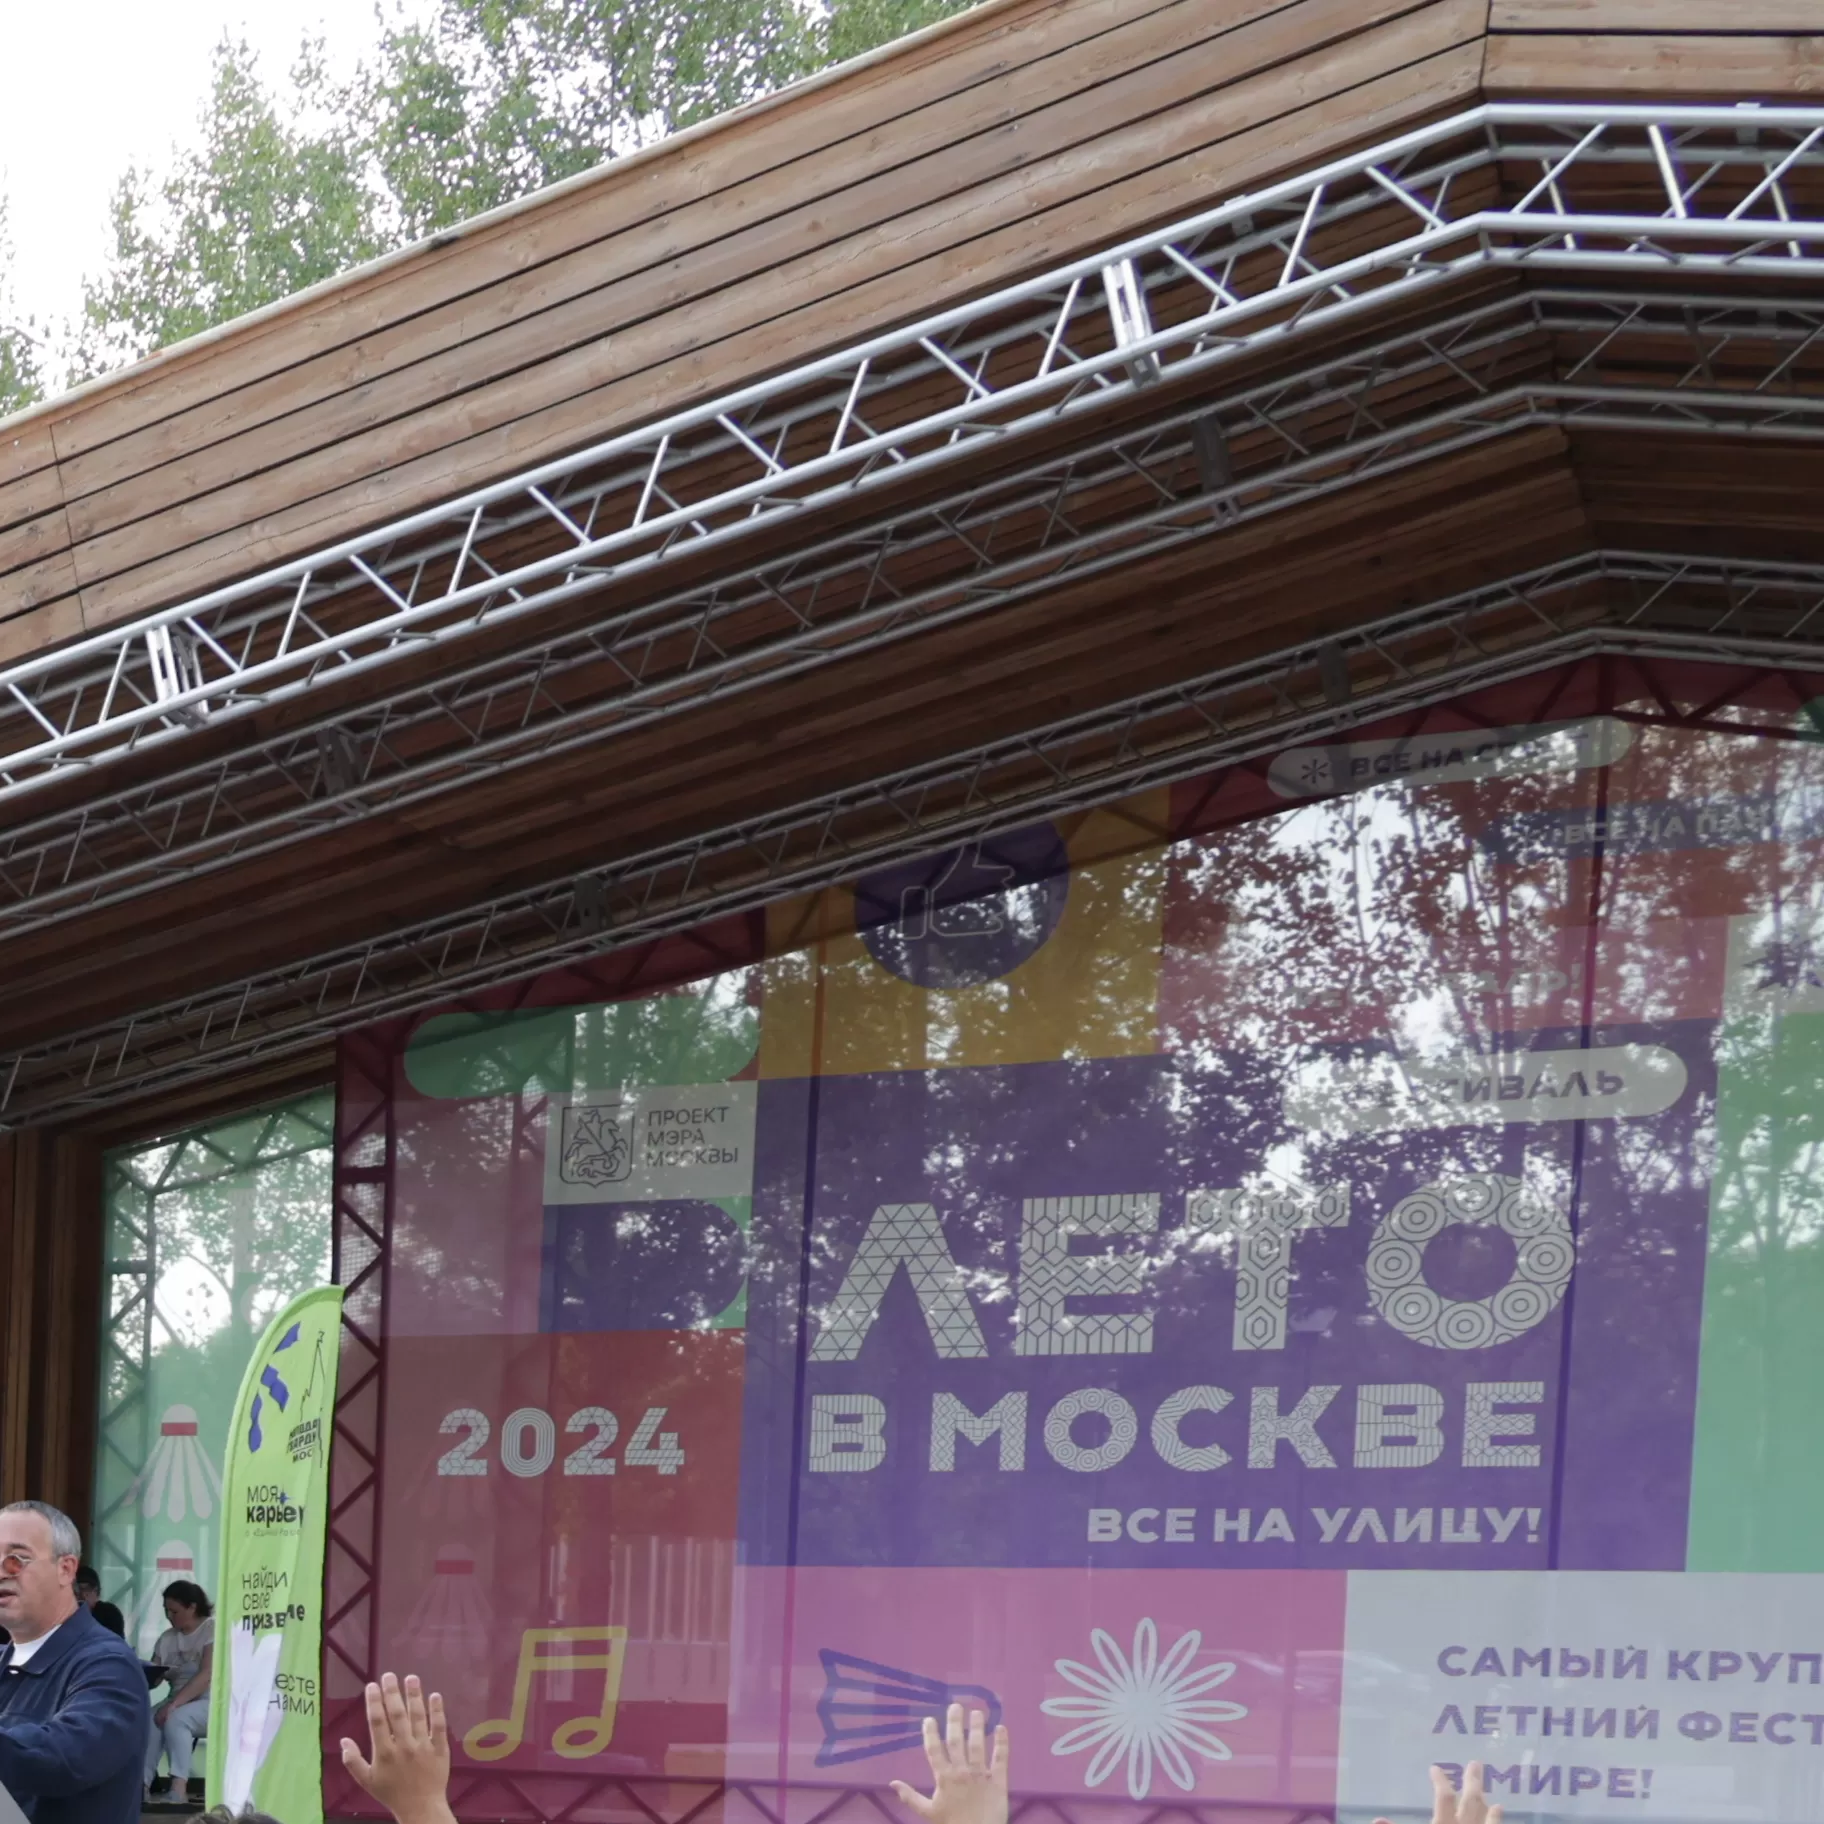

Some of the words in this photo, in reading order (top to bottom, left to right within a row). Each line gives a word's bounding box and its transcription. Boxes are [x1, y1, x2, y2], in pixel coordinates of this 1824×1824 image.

[648, 1106, 730, 1127] ПРОЕКТ
[647, 1129, 706, 1147] МЭРА
[646, 1147, 739, 1168] МОСКВЫ
[807, 1171, 1577, 1361] ЛЕТО
[437, 1405, 686, 1477] 2024
[808, 1393, 886, 1473] В
[929, 1380, 1545, 1473] МОСКВЕ
[246, 1485, 279, 1504] МОЯ
[1087, 1508, 1196, 1543] ВСЕ
[1213, 1507, 1295, 1543] НА
[1316, 1506, 1542, 1545] УЛИЦУ!
[242, 1565, 288, 1593] найди
[1436, 1644, 1650, 1680] САМЫЙ
[1666, 1649, 1824, 1685] КРУП
[1431, 1703, 1661, 1740] ЛЕТНИЙ
[1677, 1710, 1824, 1746] ФЕСТ
[1480, 1763, 1655, 1799] МИРЕ!
